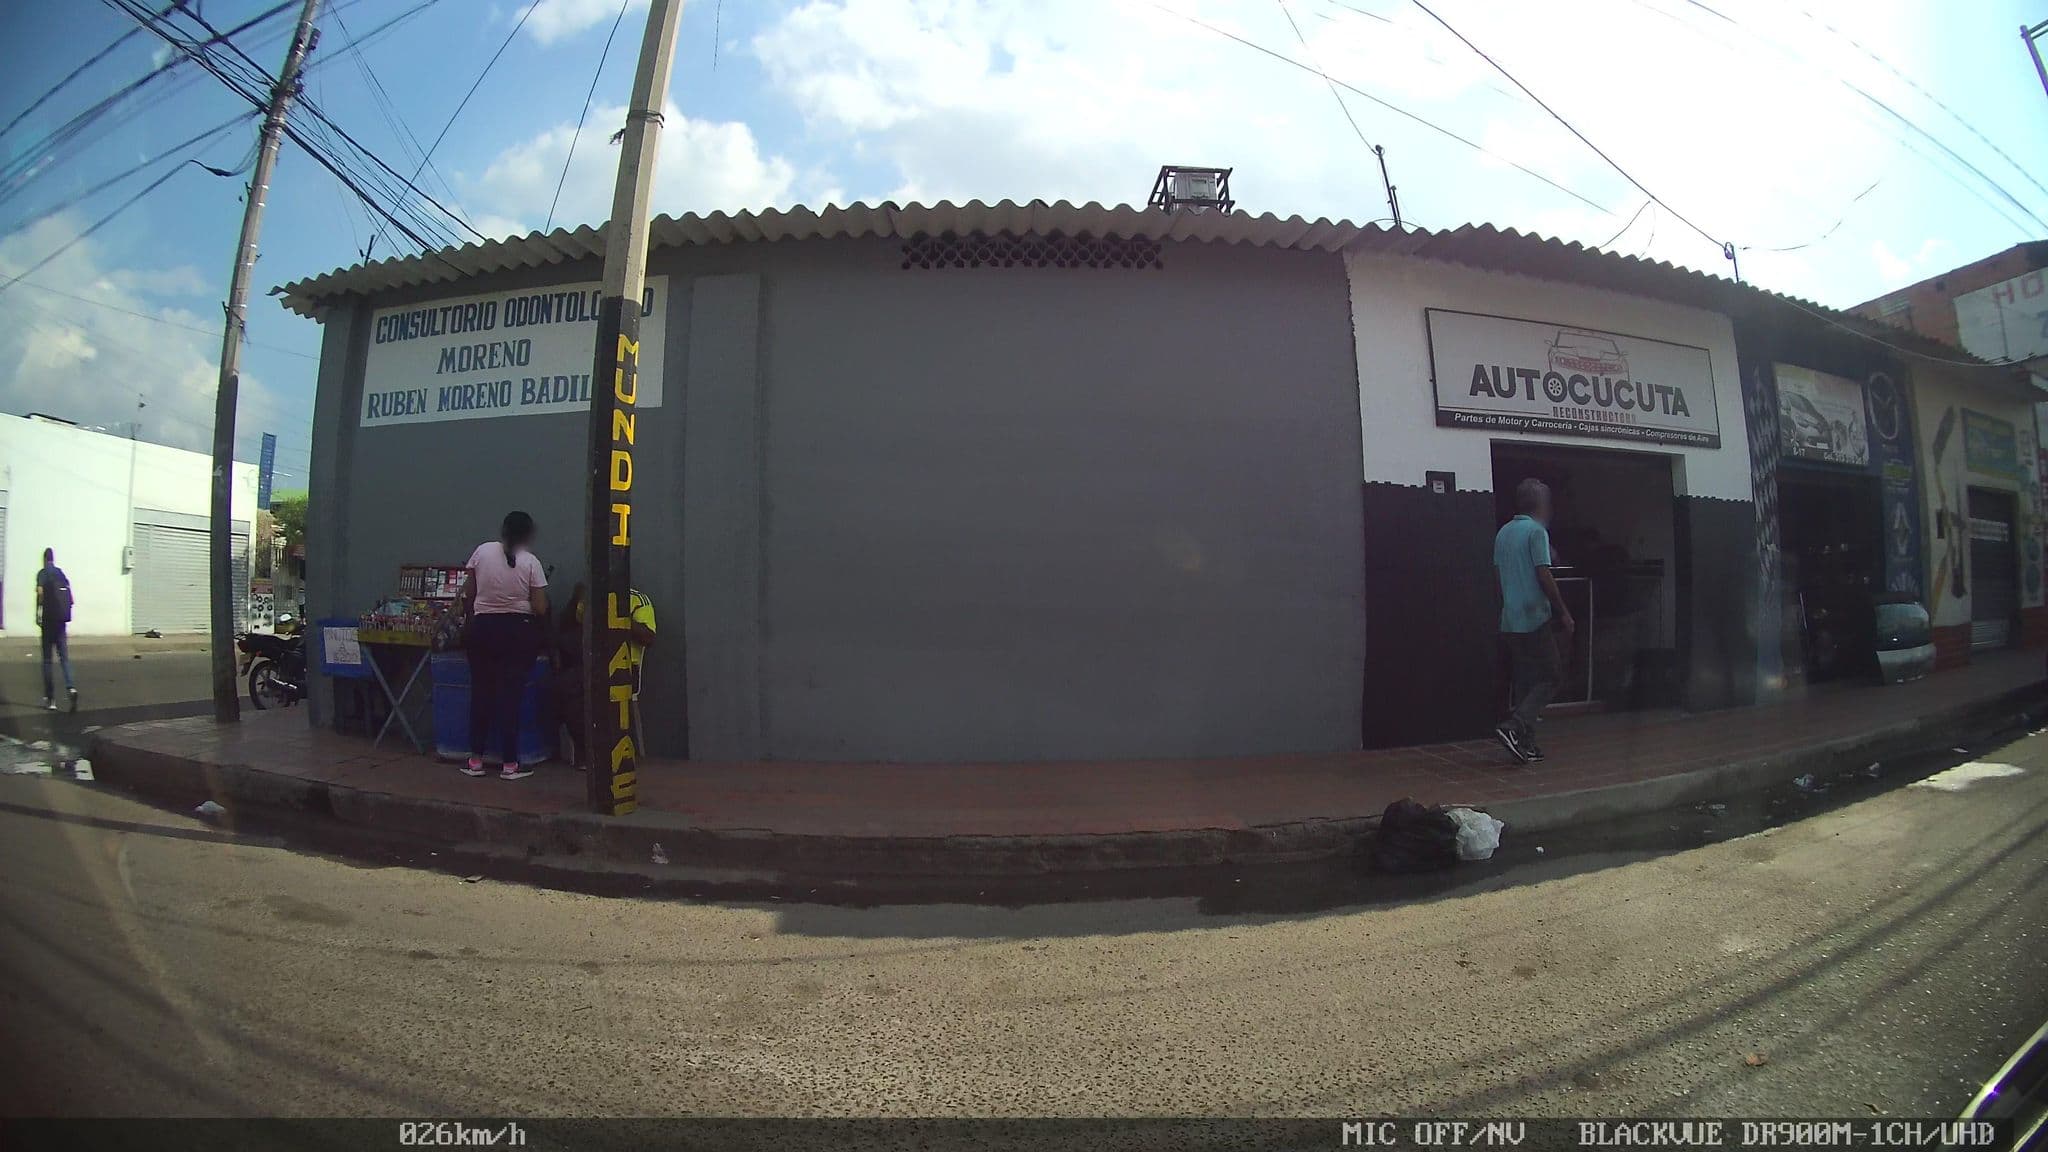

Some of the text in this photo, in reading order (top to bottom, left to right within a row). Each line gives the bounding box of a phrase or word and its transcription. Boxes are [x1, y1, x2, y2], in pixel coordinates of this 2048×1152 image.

[376, 300, 496, 345] CONSULTORIO
[436, 338, 531, 374] MORENO
[367, 374, 592, 419] RUBEN MORENO BADIL
[610, 333, 640, 546] MUNDI
[1454, 412, 1483, 423] Partes
[1485, 415, 1496, 424] de
[1498, 416, 1523, 426] Motor
[1523, 419, 1530, 428] y
[1578, 422, 1599, 433] Cajas
[1645, 429, 1687, 441] Compresores
